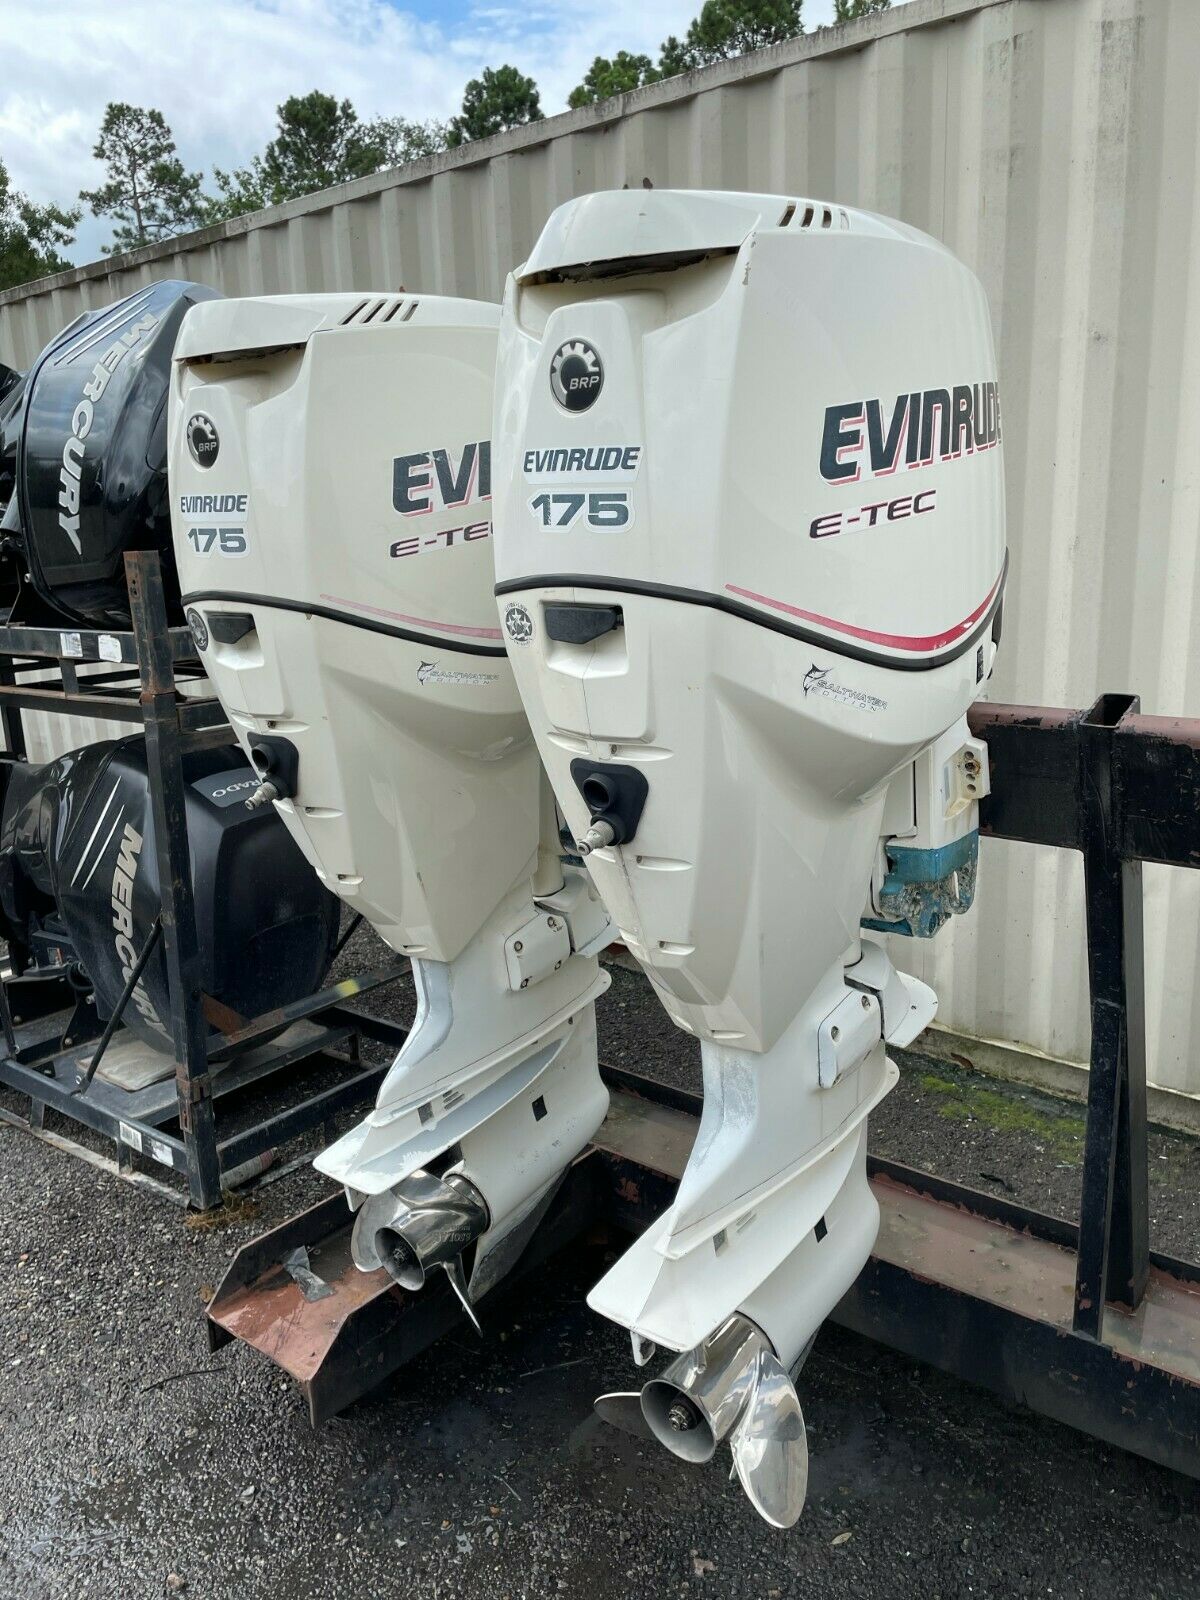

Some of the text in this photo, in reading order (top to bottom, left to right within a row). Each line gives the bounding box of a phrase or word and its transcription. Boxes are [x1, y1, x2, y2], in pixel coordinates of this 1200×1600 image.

[569, 375, 600, 390] BRP
[59, 313, 159, 555] MERCURY
[198, 441, 217, 452] BRP
[523, 446, 641, 473] EVINRUDE
[180, 495, 248, 513] EVINRUDE
[531, 493, 629, 526] 175
[809, 489, 936, 539] E-TEC
[187, 528, 247, 553] 175
[389, 521, 493, 558] E-TE
[811, 686, 876, 711] EDITION
[817, 680, 888, 709] SALTWATER
